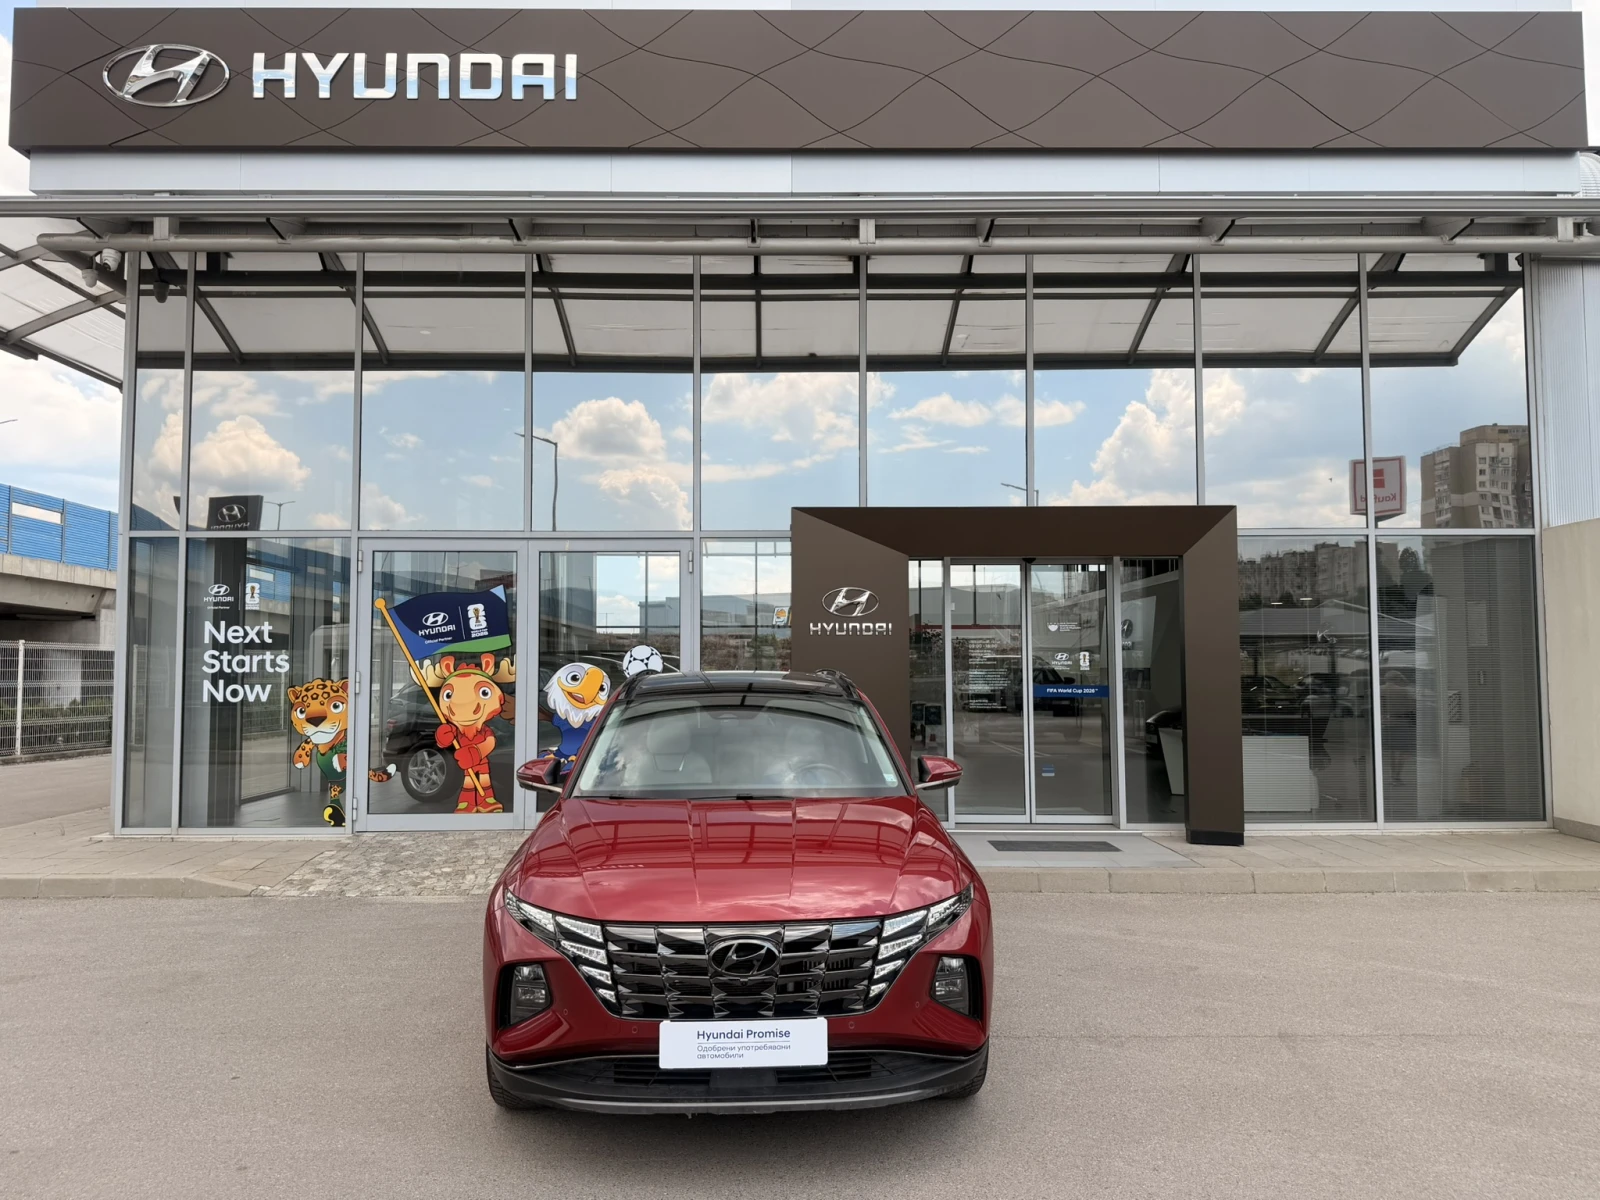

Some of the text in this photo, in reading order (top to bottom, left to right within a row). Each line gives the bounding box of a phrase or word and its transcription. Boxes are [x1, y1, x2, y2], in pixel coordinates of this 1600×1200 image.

[251, 52, 578, 101] HYUNDAI
[204, 620, 273, 644] Next
[418, 624, 456, 636] HYUNDAI
[809, 622, 893, 636] HYUNDAI
[201, 649, 290, 674] Starts
[202, 679, 272, 703] Now
[696, 1028, 791, 1041] Hyundai Promise
[696, 1043, 791, 1053] Одобрени употребявани
[696, 1052, 744, 1060] автомобили
